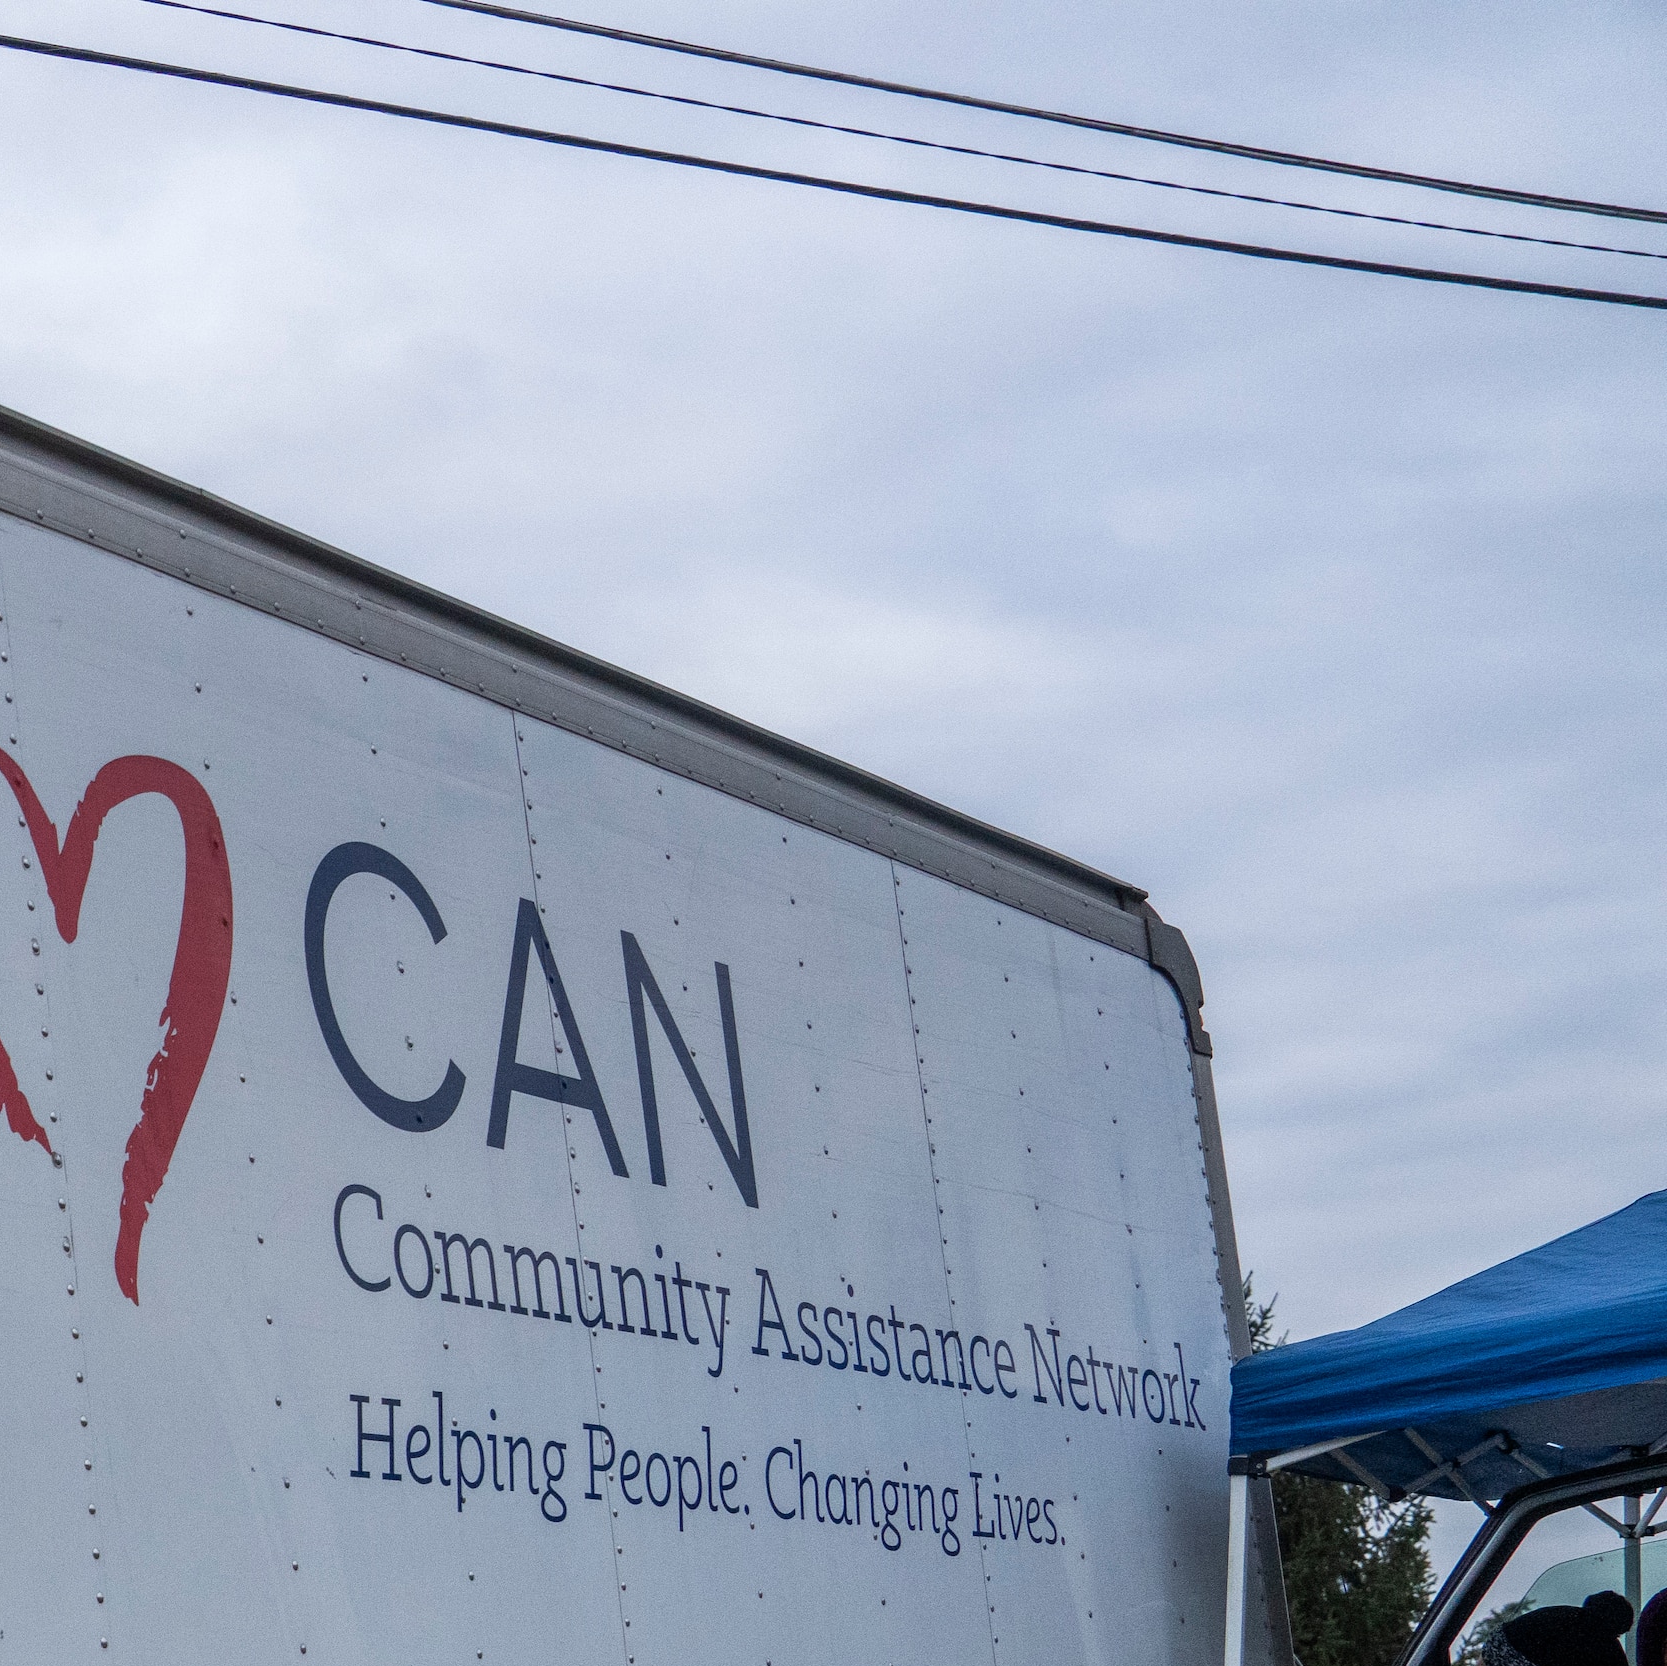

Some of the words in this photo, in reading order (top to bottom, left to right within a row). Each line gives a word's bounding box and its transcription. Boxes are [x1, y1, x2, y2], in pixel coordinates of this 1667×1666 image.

[304, 841, 760, 1208] CAN
[333, 1183, 730, 1378] Community
[752, 1268, 1018, 1399] Assistance
[1024, 1324, 1206, 1431] Network
[350, 1391, 567, 1522] Helping
[584, 1422, 749, 1531] People.
[764, 1441, 960, 1555] Changing
[970, 1473, 1066, 1546] Lives.
